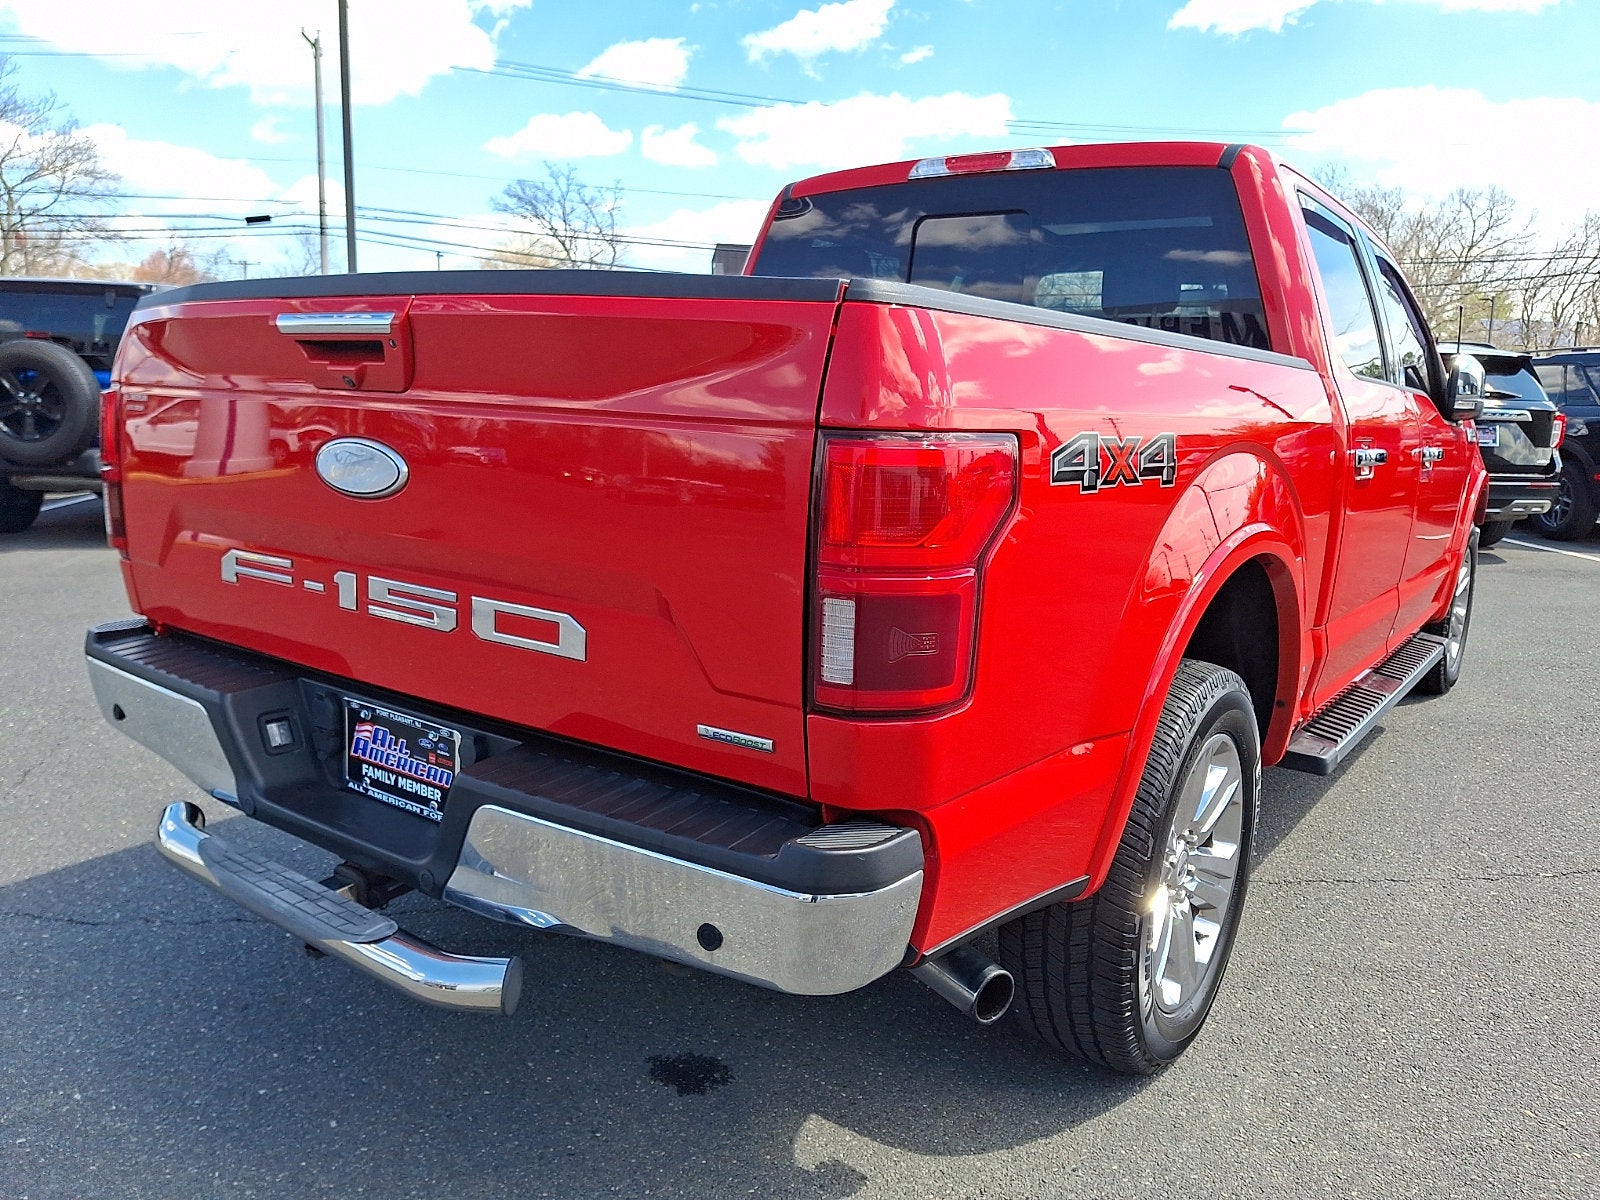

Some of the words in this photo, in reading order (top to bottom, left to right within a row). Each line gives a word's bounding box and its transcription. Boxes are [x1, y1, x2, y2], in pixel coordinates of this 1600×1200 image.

[221, 548, 587, 662] F-150
[361, 763, 397, 786] FAMILY
[397, 775, 442, 803] MEMBER
[348, 781, 366, 794] ALL
[367, 790, 421, 813] AMERICAN
